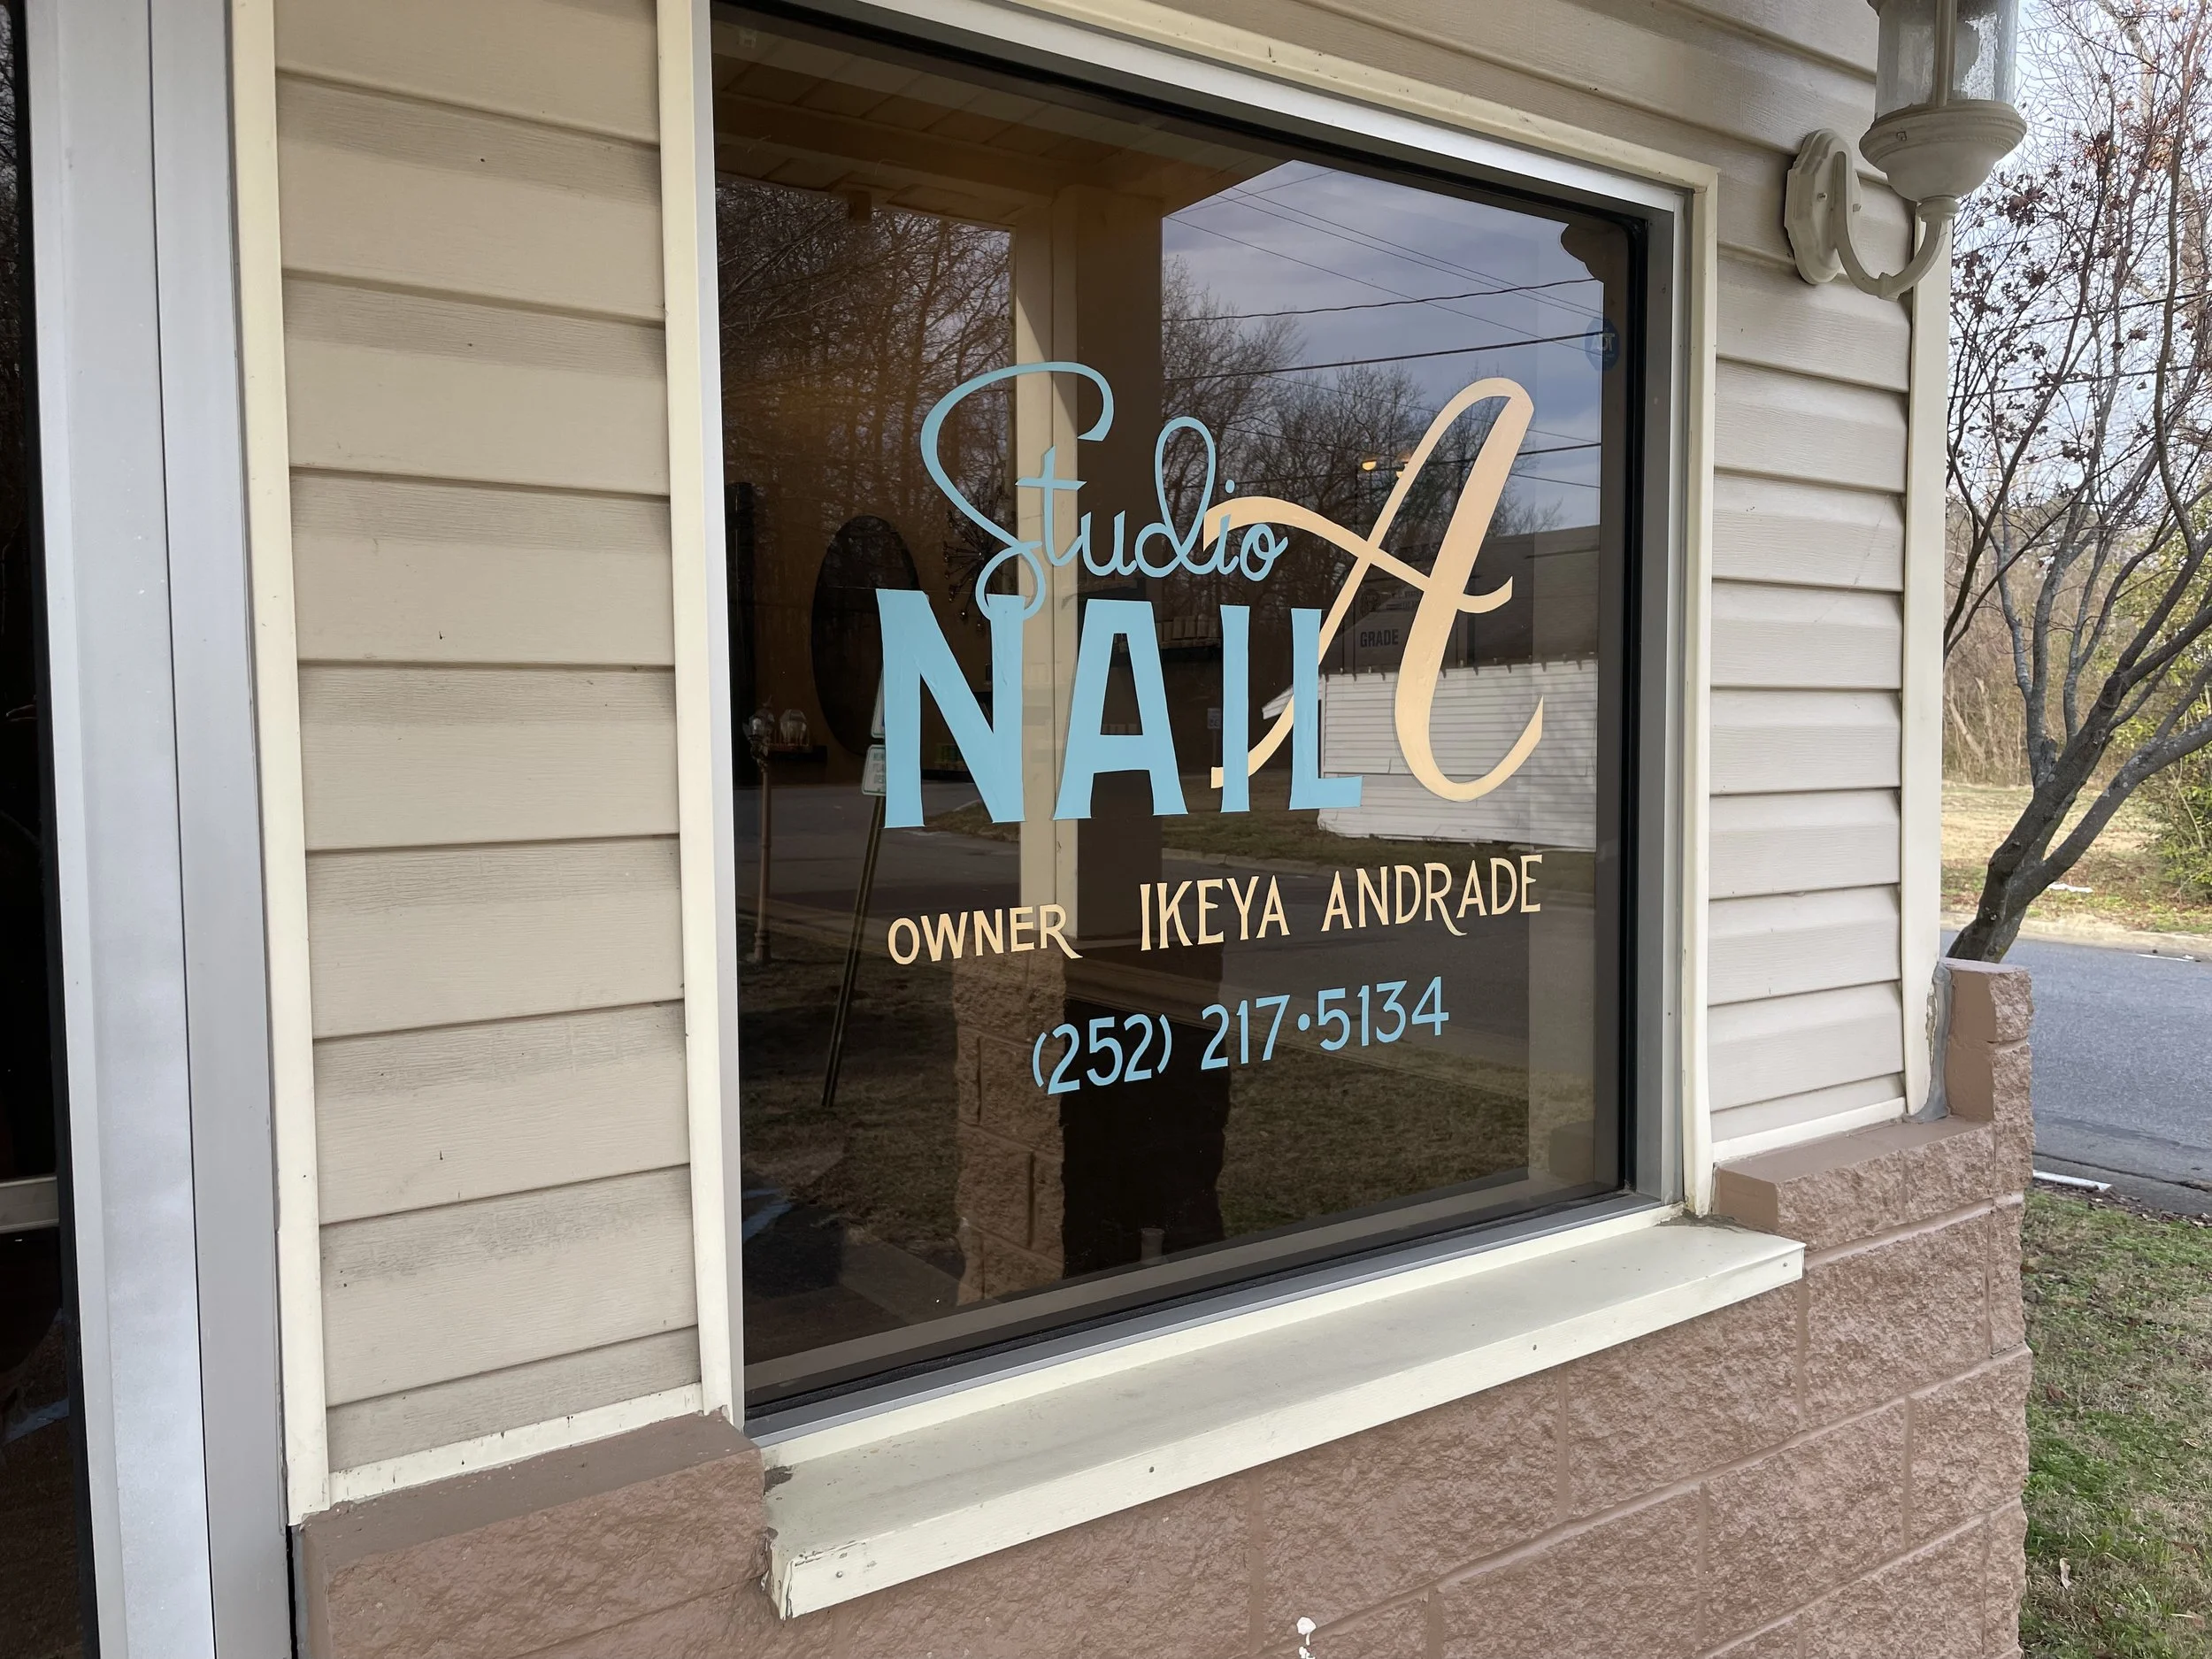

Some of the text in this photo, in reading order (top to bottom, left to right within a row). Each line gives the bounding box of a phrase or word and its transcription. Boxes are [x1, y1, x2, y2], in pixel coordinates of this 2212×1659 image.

[920, 361, 1544, 803] Studio A
[1360, 629, 1399, 648] GRADE
[877, 588, 1363, 828] NAIL
[887, 854, 1544, 965] OWNER IKEYA ANDRADE
[1032, 1014, 1172, 1095] (252)
